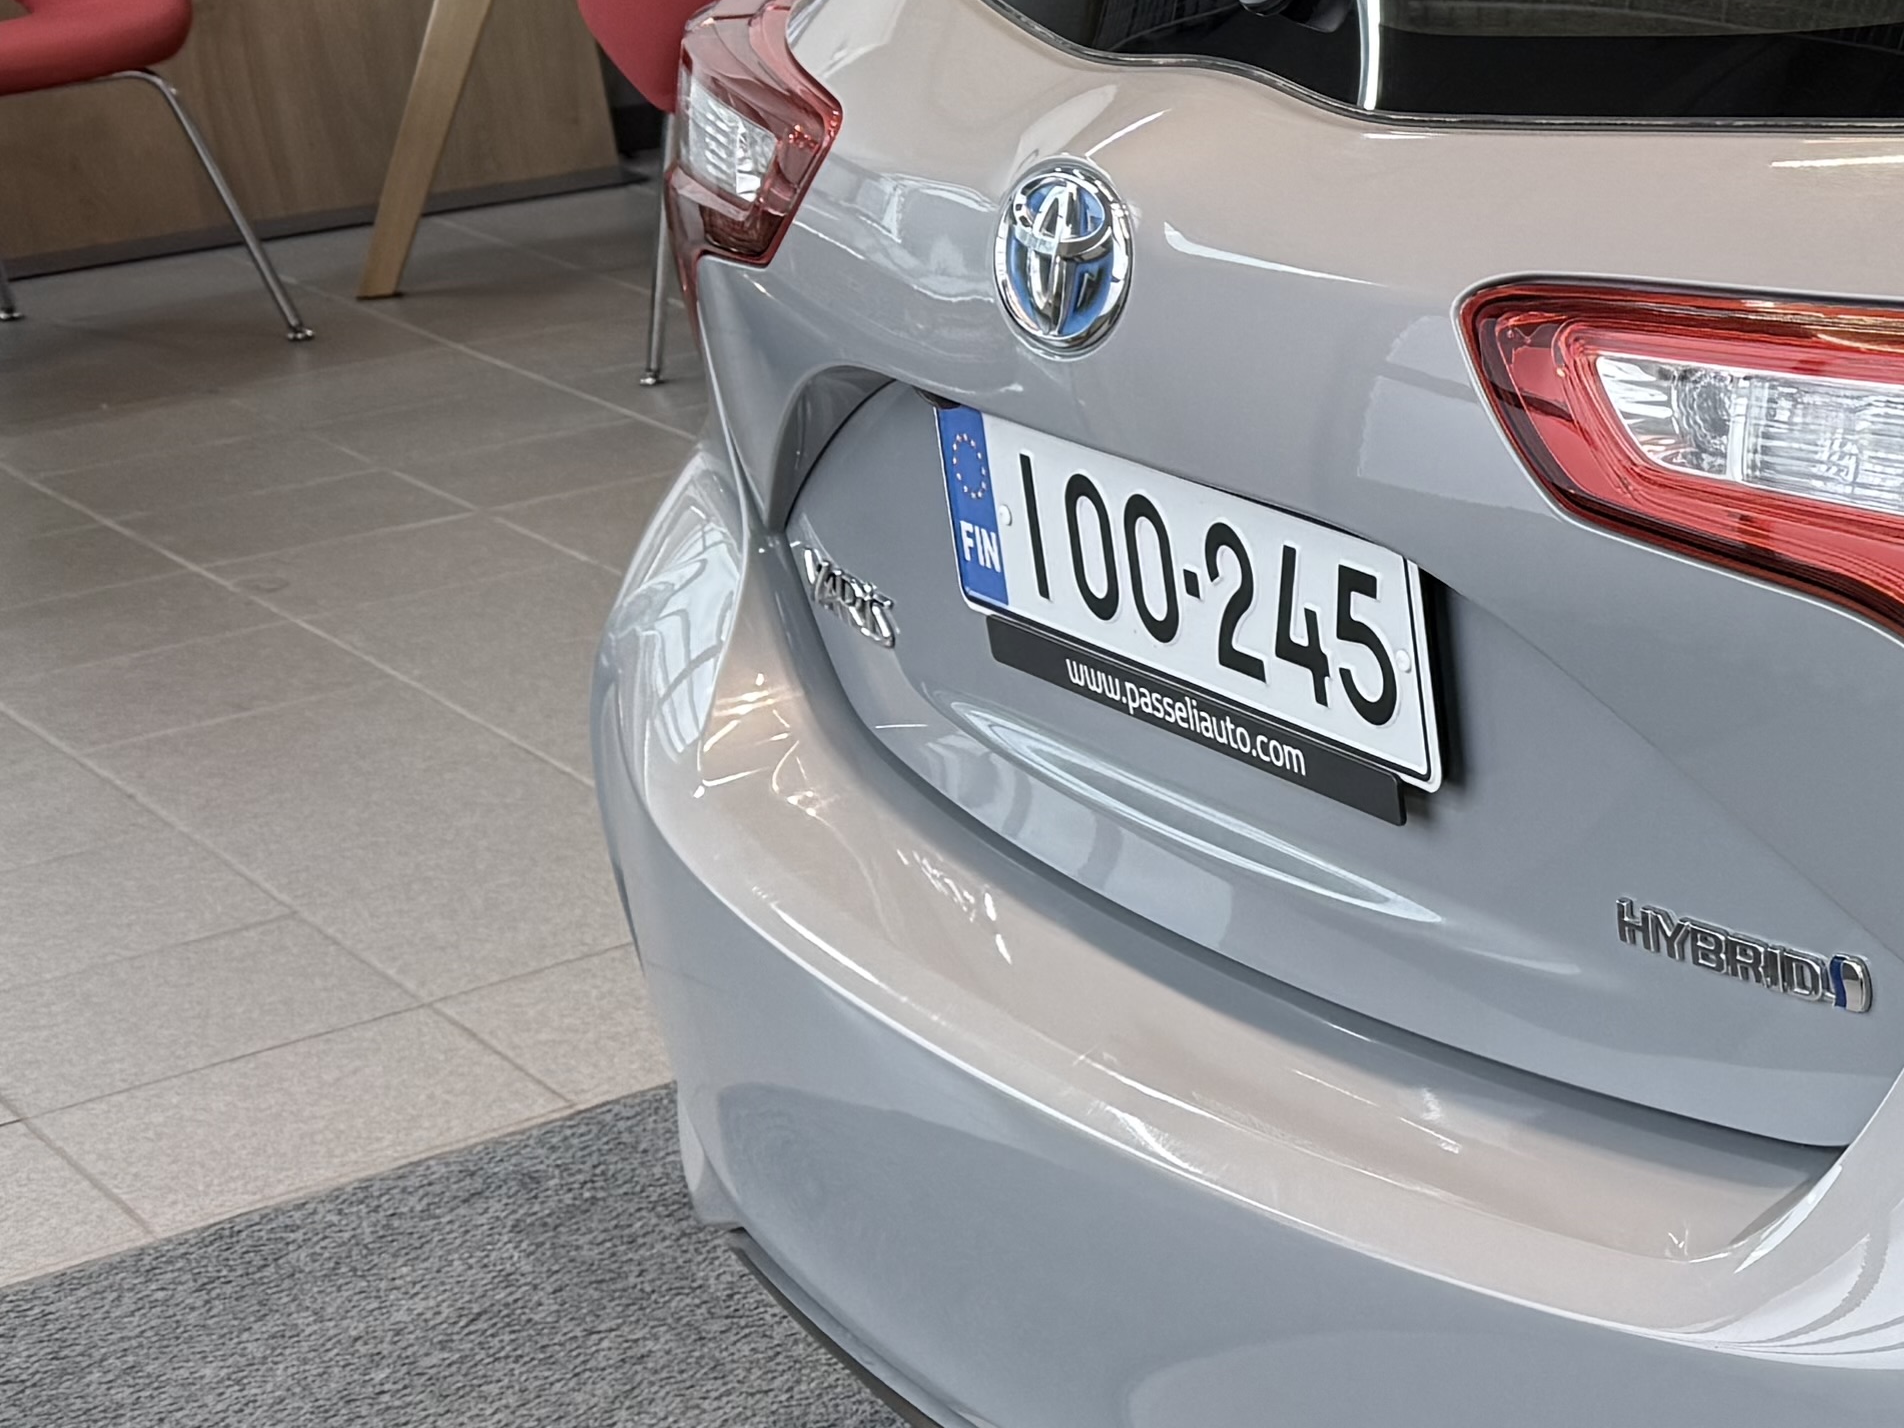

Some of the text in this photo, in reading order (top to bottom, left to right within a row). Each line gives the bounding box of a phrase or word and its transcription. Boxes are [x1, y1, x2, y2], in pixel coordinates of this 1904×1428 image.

[960, 520, 1002, 574] FIN
[1066, 656, 1308, 778] www.passeliauto.com
[1615, 896, 1840, 1004] HYBRID
